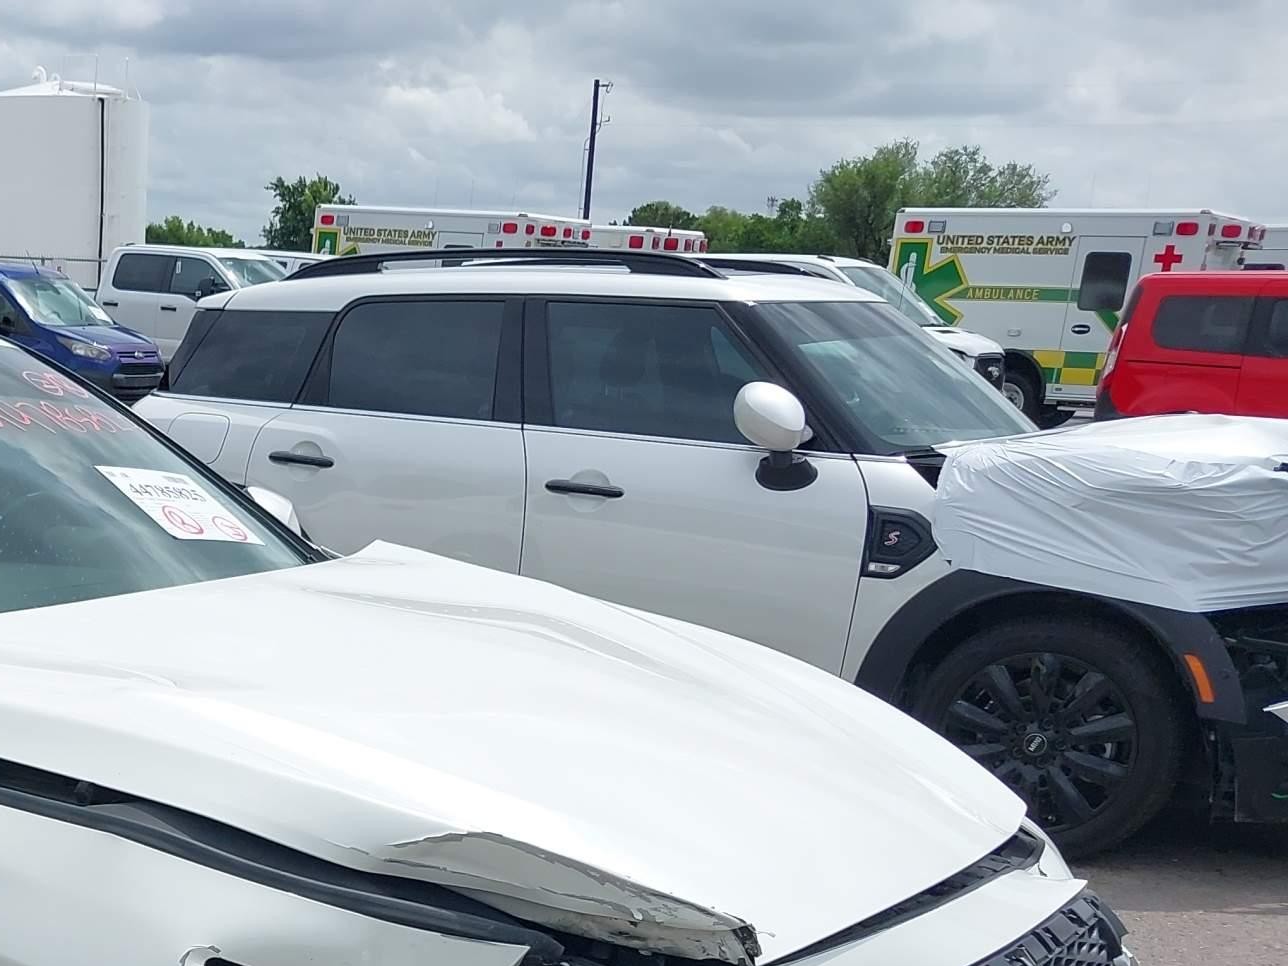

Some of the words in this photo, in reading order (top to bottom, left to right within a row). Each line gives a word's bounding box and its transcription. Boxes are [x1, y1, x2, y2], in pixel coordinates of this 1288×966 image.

[343, 226, 376, 236] UNITED
[376, 229, 408, 239] STATES
[409, 230, 437, 241] ARMY
[937, 235, 984, 246] UNITED
[986, 235, 1034, 246] STATES
[1035, 236, 1077, 247] ARMY
[940, 247, 992, 255] EMERGENCY
[992, 247, 1031, 255] MEDICAL
[1032, 247, 1070, 255] SERVICE
[966, 287, 1040, 300] AMBULANCE
[128, 484, 207, 502] 44785825
[883, 531, 901, 546] S
